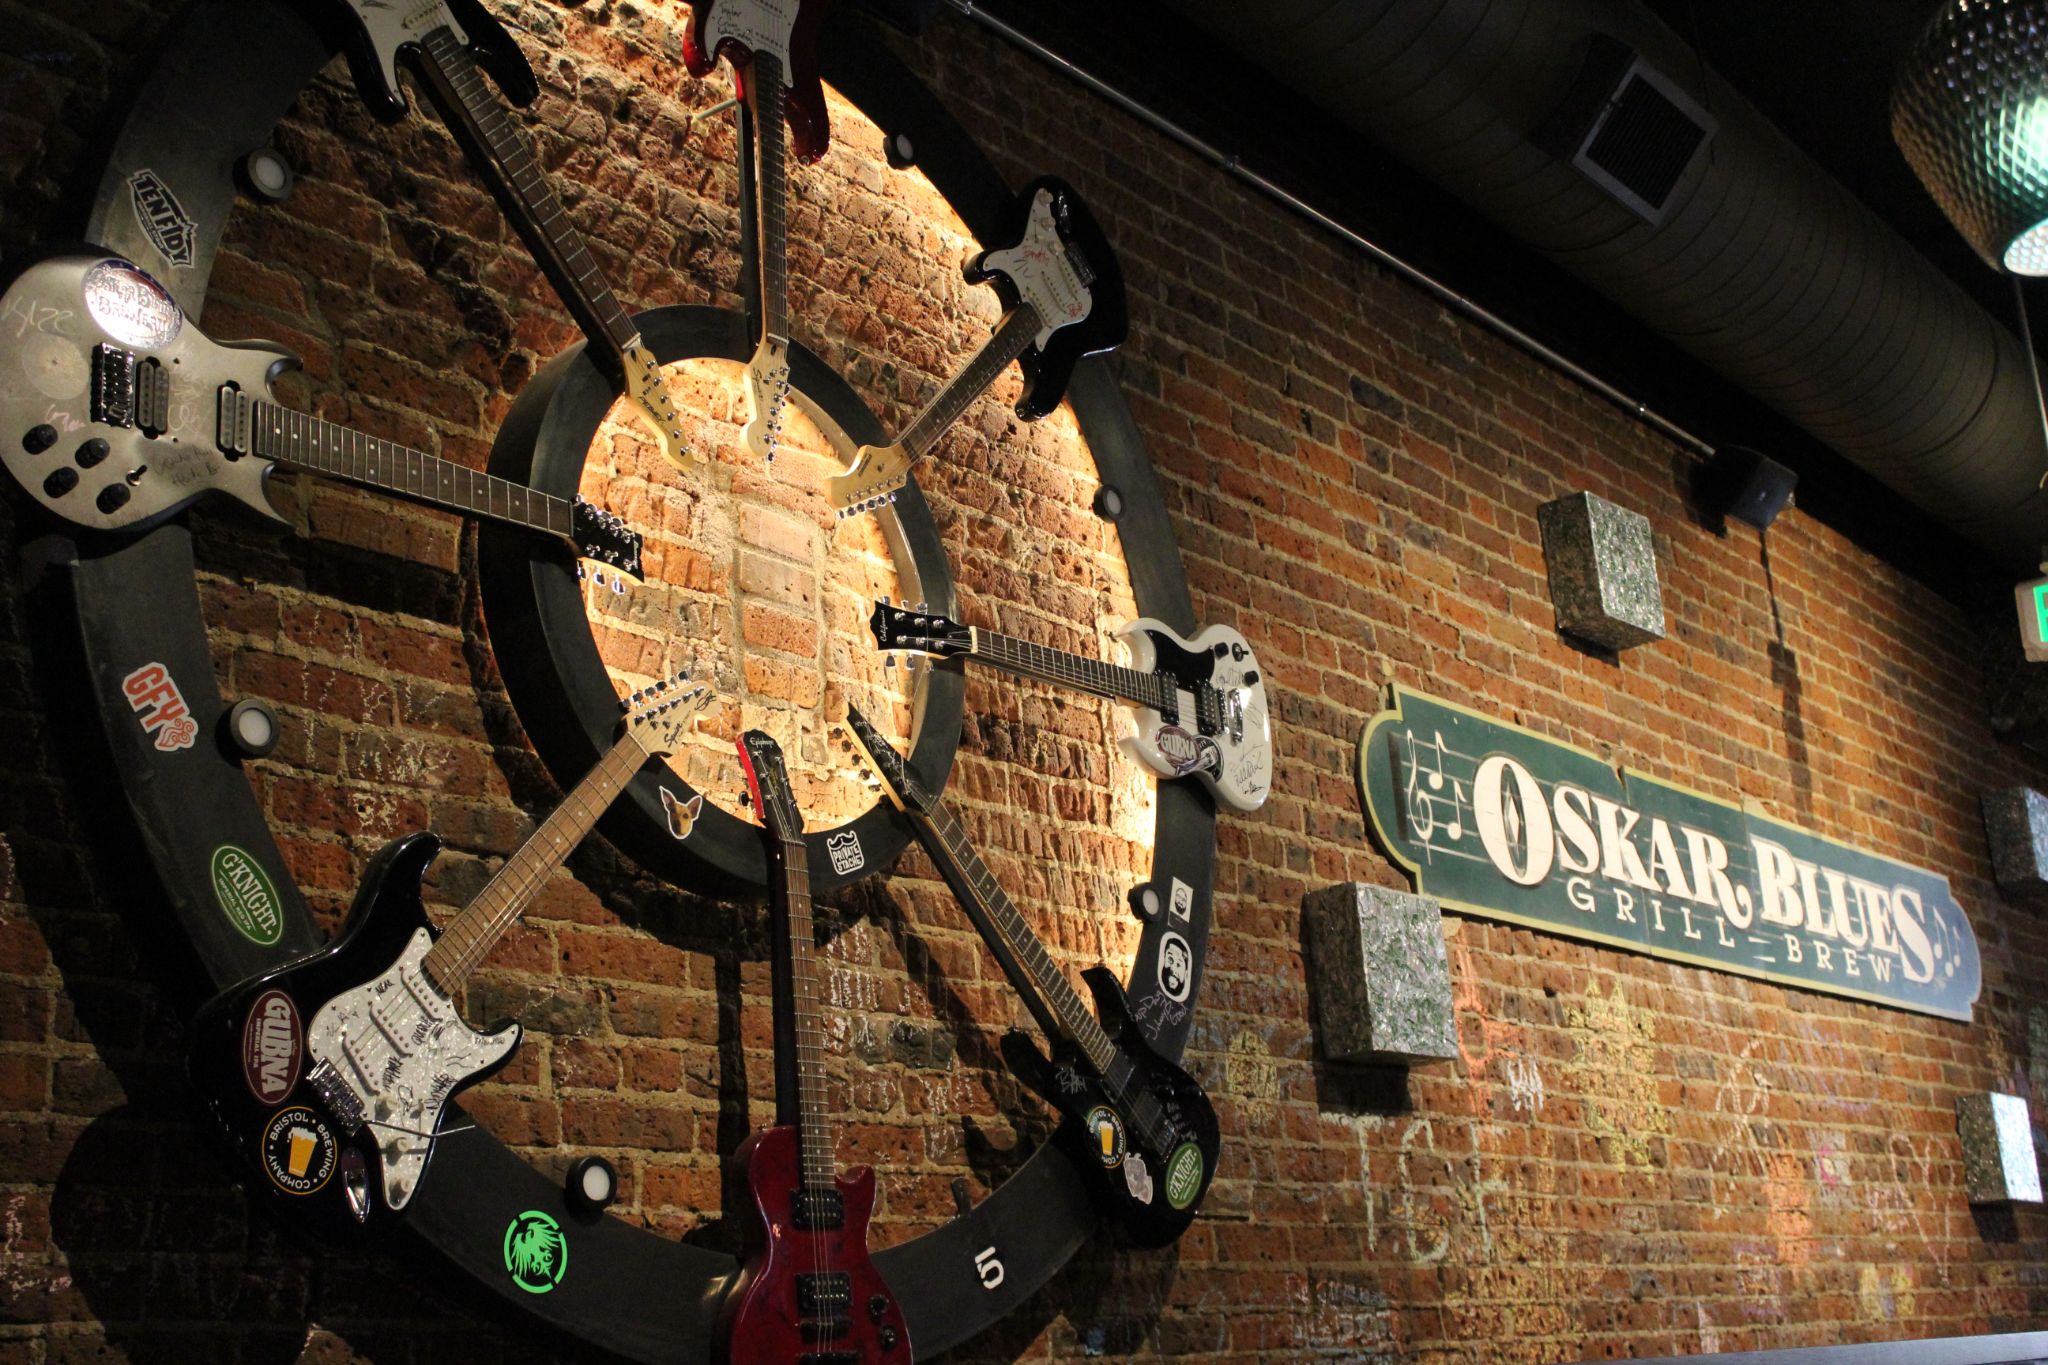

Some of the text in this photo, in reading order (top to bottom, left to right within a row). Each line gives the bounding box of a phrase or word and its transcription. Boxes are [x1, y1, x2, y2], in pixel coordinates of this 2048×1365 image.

[133, 174, 173, 217] TEN
[154, 217, 191, 263] FIDY
[880, 609, 889, 642] California
[126, 666, 186, 728] GFY
[750, 737, 775, 749] Epiphone
[832, 843, 860, 863] PRIVATE
[837, 855, 862, 872] STACHE
[1473, 756, 1934, 983] OSKAR BLUES
[1567, 876, 1892, 983] GRILL BREW
[260, 997, 292, 1094] GUBNA
[268, 1112, 334, 1190] BRISTOL BREWING COMPANY
[974, 1246, 1005, 1290] 5
